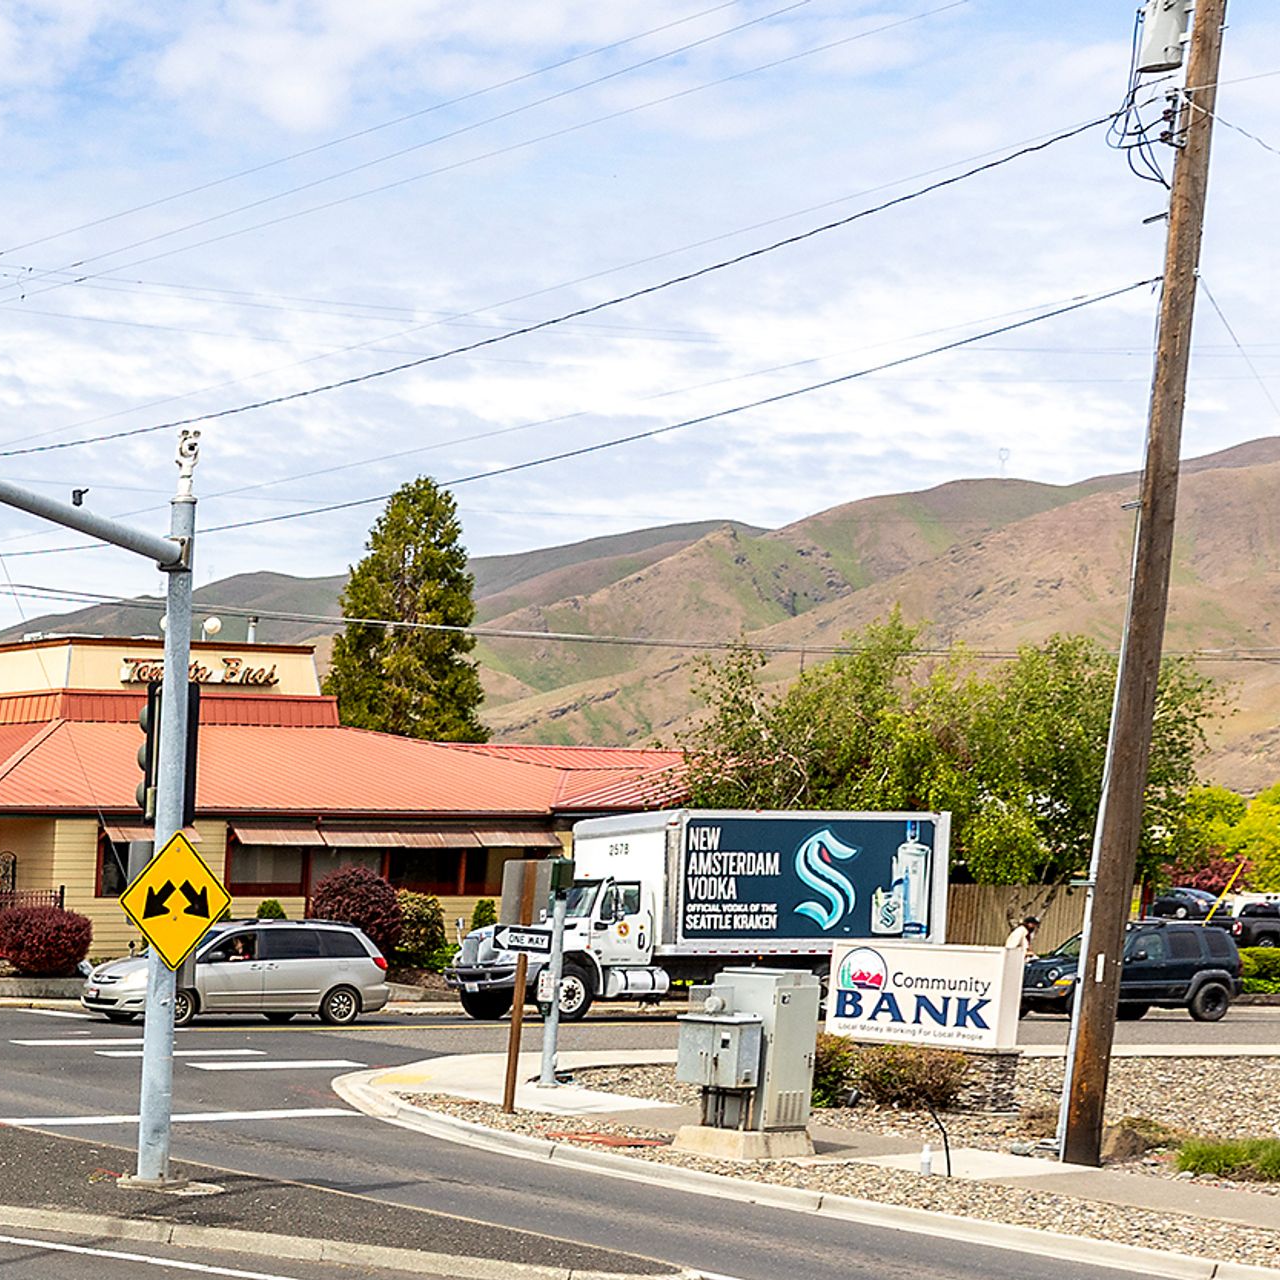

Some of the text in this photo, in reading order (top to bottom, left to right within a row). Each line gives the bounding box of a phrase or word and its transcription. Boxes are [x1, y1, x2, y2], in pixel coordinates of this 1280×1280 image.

[123, 657, 212, 684] Tomto
[688, 827, 721, 851] NEW
[687, 852, 781, 875] AMSTERDAM
[687, 876, 738, 900] VODKA
[686, 903, 778, 913] OFFICIAL VODKA OF THE
[685, 914, 778, 930] SEATTLE KRAKEN
[508, 932, 546, 946] ONE WAY
[892, 971, 991, 997] Community
[833, 989, 992, 1030] BANK
[838, 1023, 984, 1041] Local Money Working For Local People
